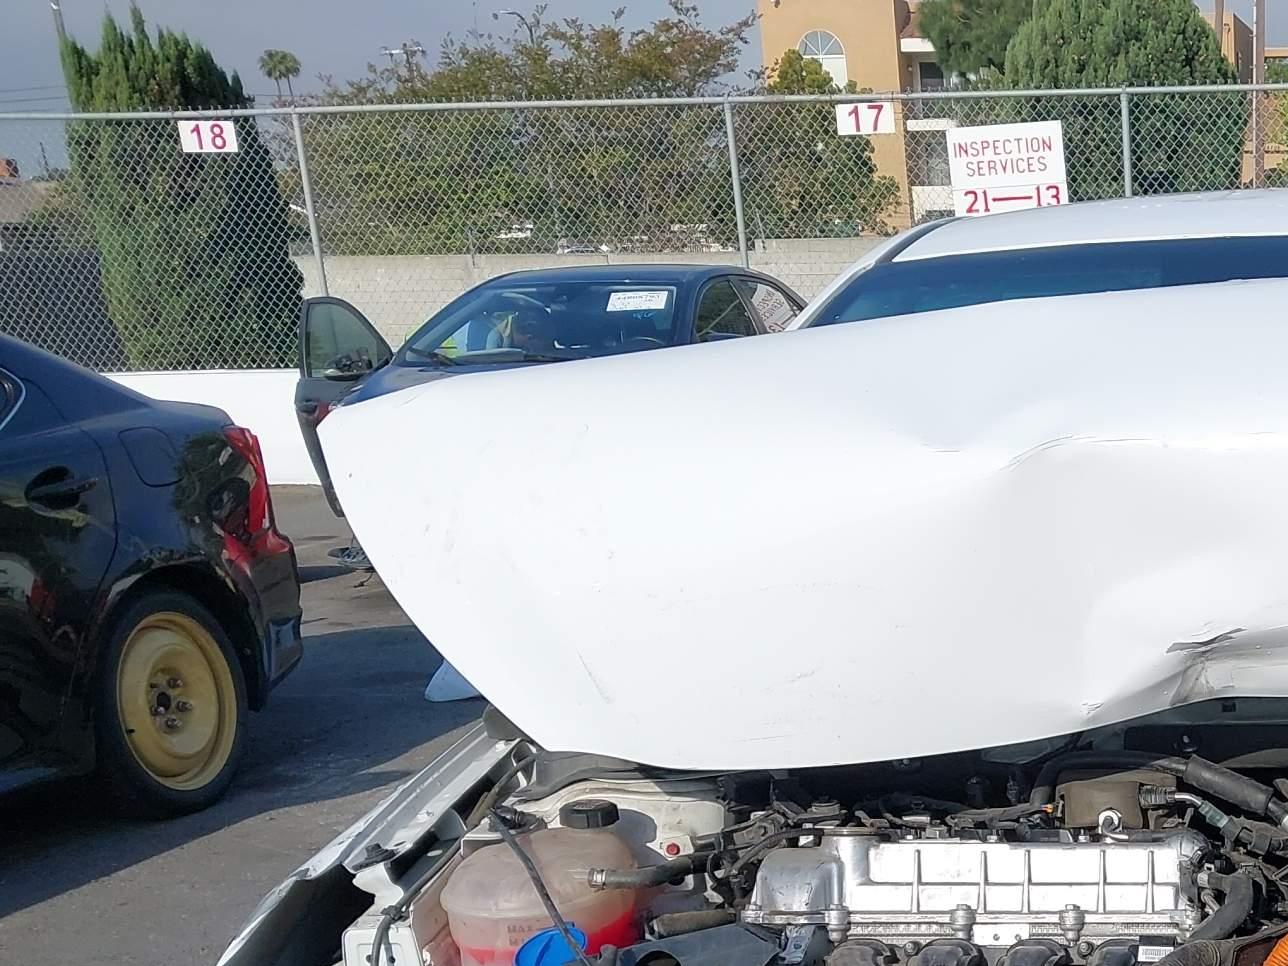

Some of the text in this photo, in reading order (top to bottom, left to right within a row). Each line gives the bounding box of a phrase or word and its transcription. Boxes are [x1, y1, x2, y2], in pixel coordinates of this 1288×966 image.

[848, 104, 884, 132] 17
[190, 123, 227, 150] 18
[953, 135, 1053, 159] INSPECTION
[965, 156, 1048, 178] SERVICES
